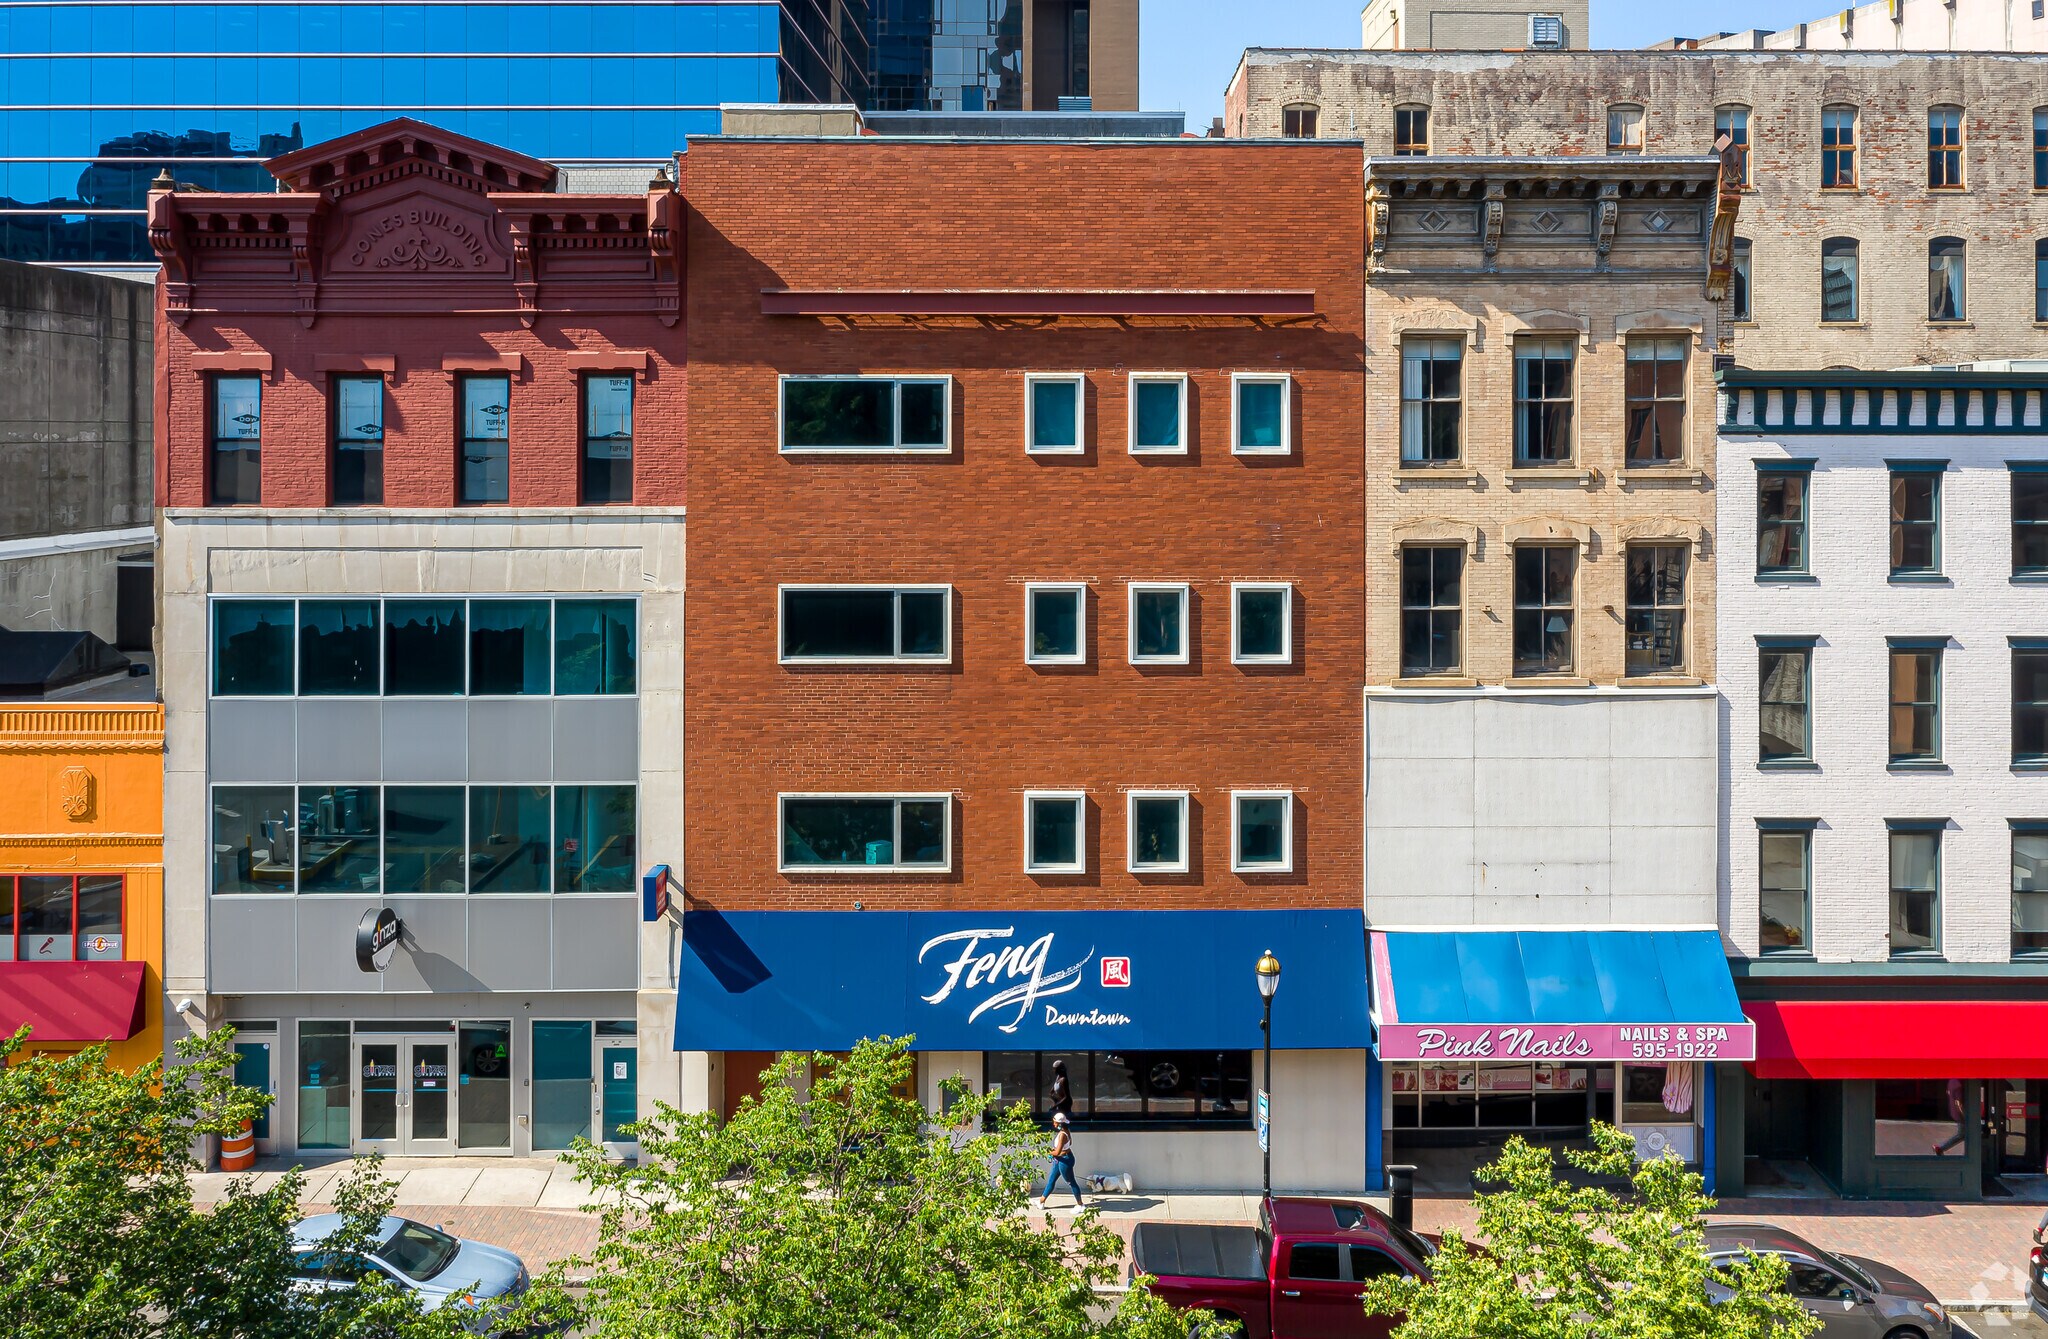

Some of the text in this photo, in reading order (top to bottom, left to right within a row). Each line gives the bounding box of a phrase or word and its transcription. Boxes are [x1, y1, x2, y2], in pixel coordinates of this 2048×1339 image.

[409, 210, 487, 266] BUILDING
[372, 919, 396, 952] ginza
[918, 925, 1095, 1034] Feng
[1104, 959, 1128, 984] 風
[1045, 1004, 1131, 1026] Downtown
[1416, 1027, 1593, 1057] Pink Nails
[1620, 1027, 1729, 1042] NAILS & SPA
[497, 1044, 505, 1053] A
[1632, 1043, 1719, 1059] 595-1922
